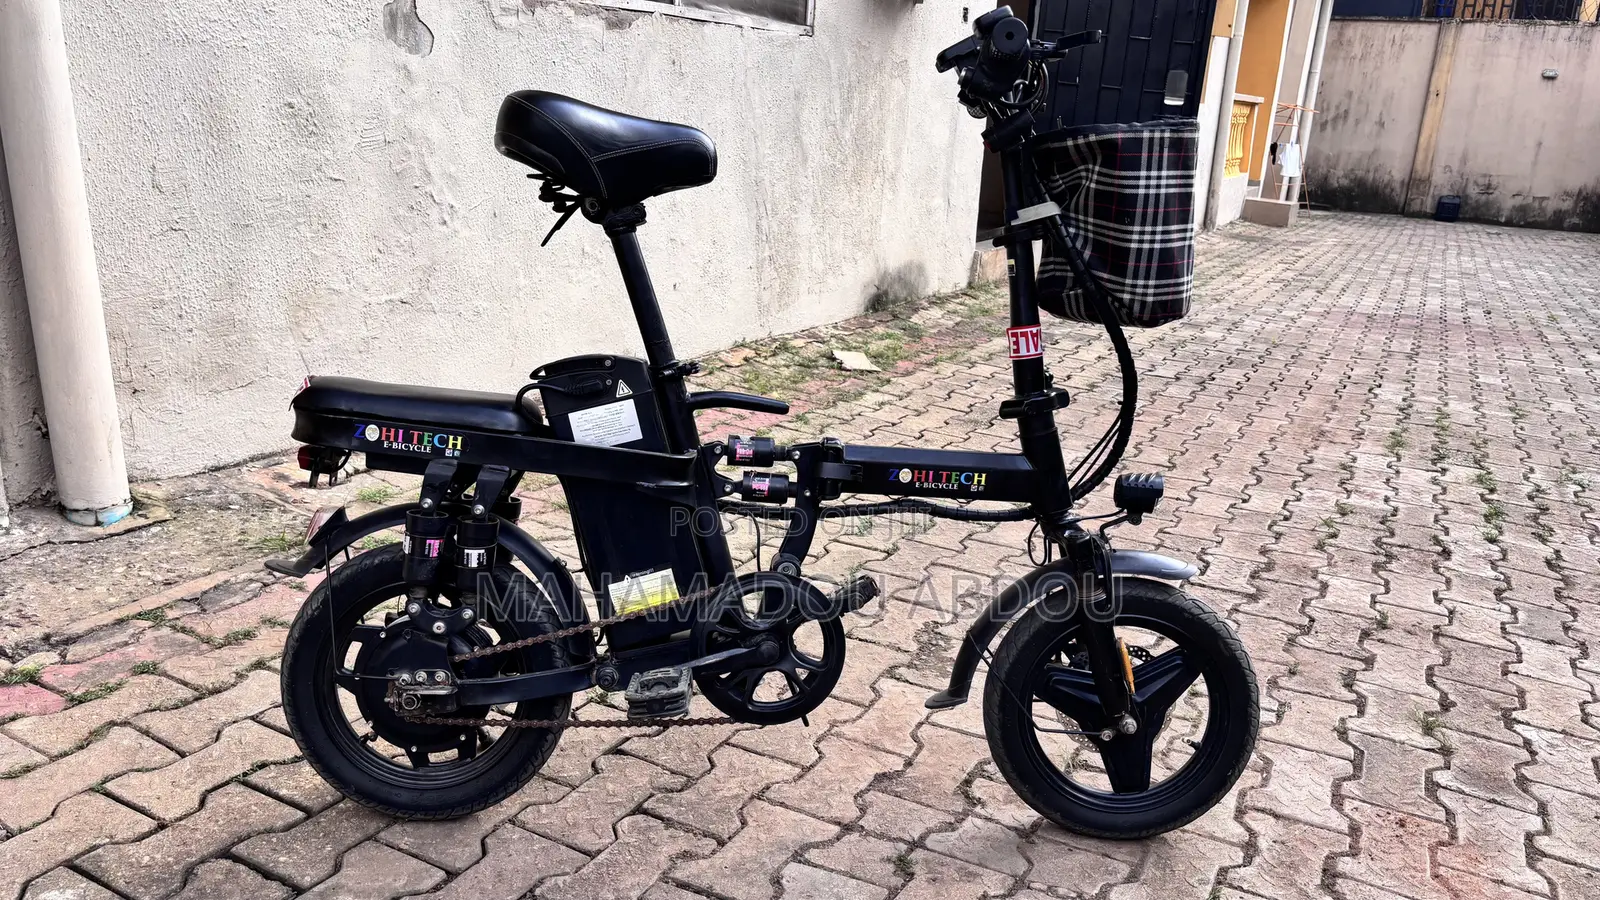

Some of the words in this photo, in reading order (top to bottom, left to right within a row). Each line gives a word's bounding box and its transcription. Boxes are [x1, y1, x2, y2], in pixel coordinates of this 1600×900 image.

[1011, 329, 1039, 354] ALE
[383, 440, 432, 453] E-BICYCLE
[409, 431, 462, 450] TECH
[915, 481, 959, 490] E-BICYCLE
[939, 470, 987, 486] TECH
